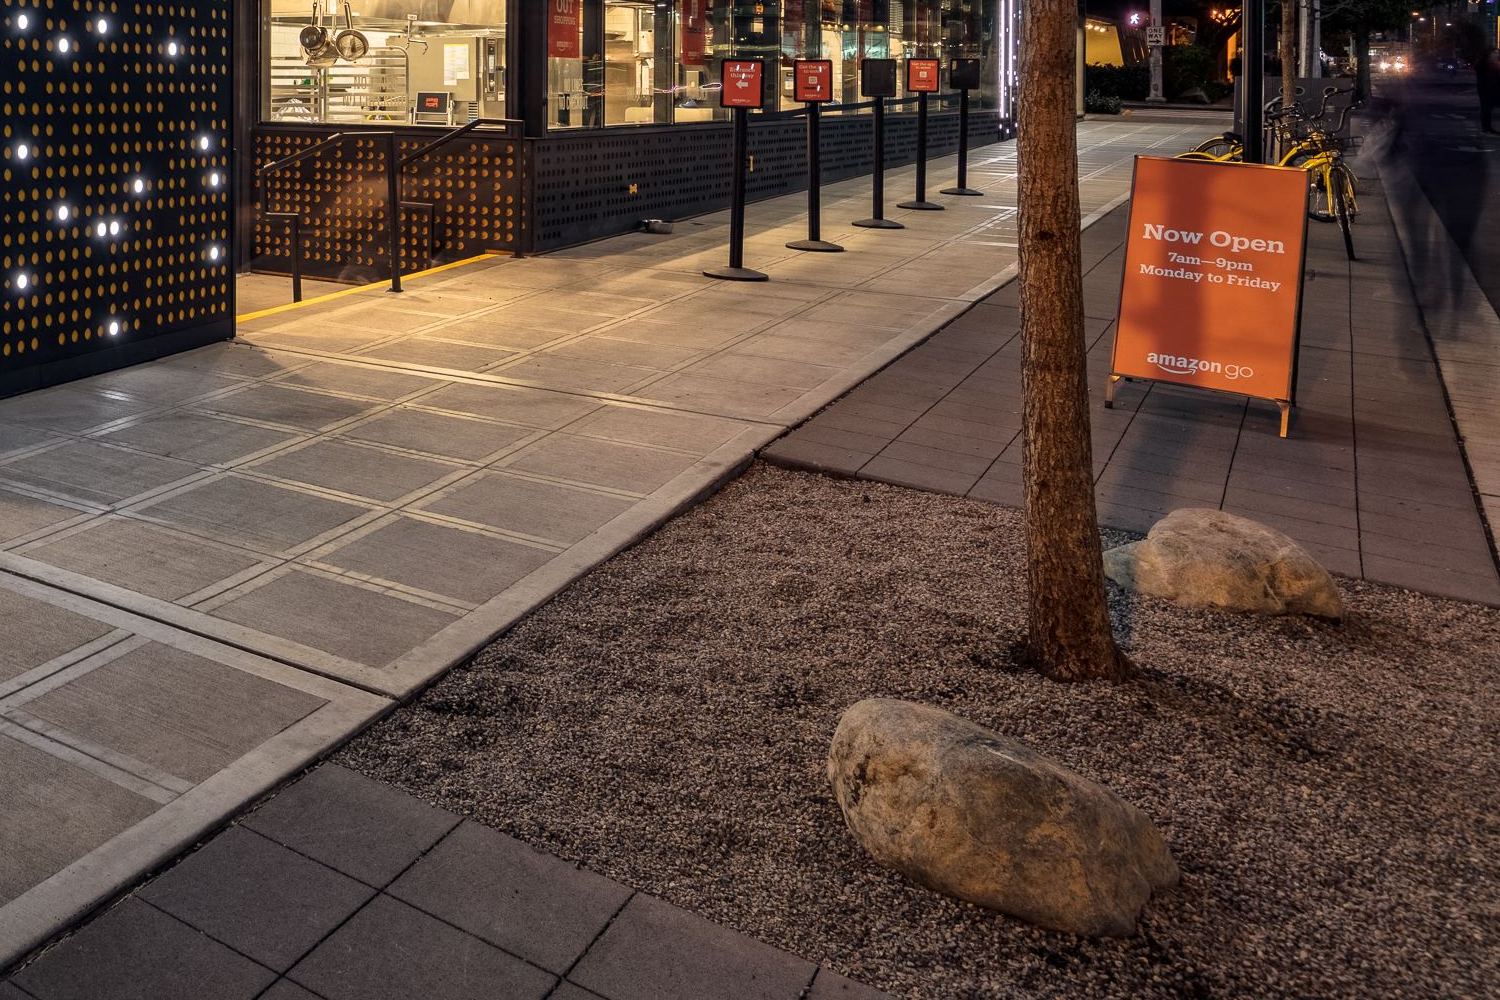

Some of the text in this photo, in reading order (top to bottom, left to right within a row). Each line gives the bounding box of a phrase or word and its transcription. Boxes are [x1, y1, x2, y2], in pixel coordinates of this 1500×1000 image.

[1142, 223, 1285, 254] Now Open
[1140, 264, 1281, 292] Monday to Friday
[1147, 352, 1253, 379] amazon go
